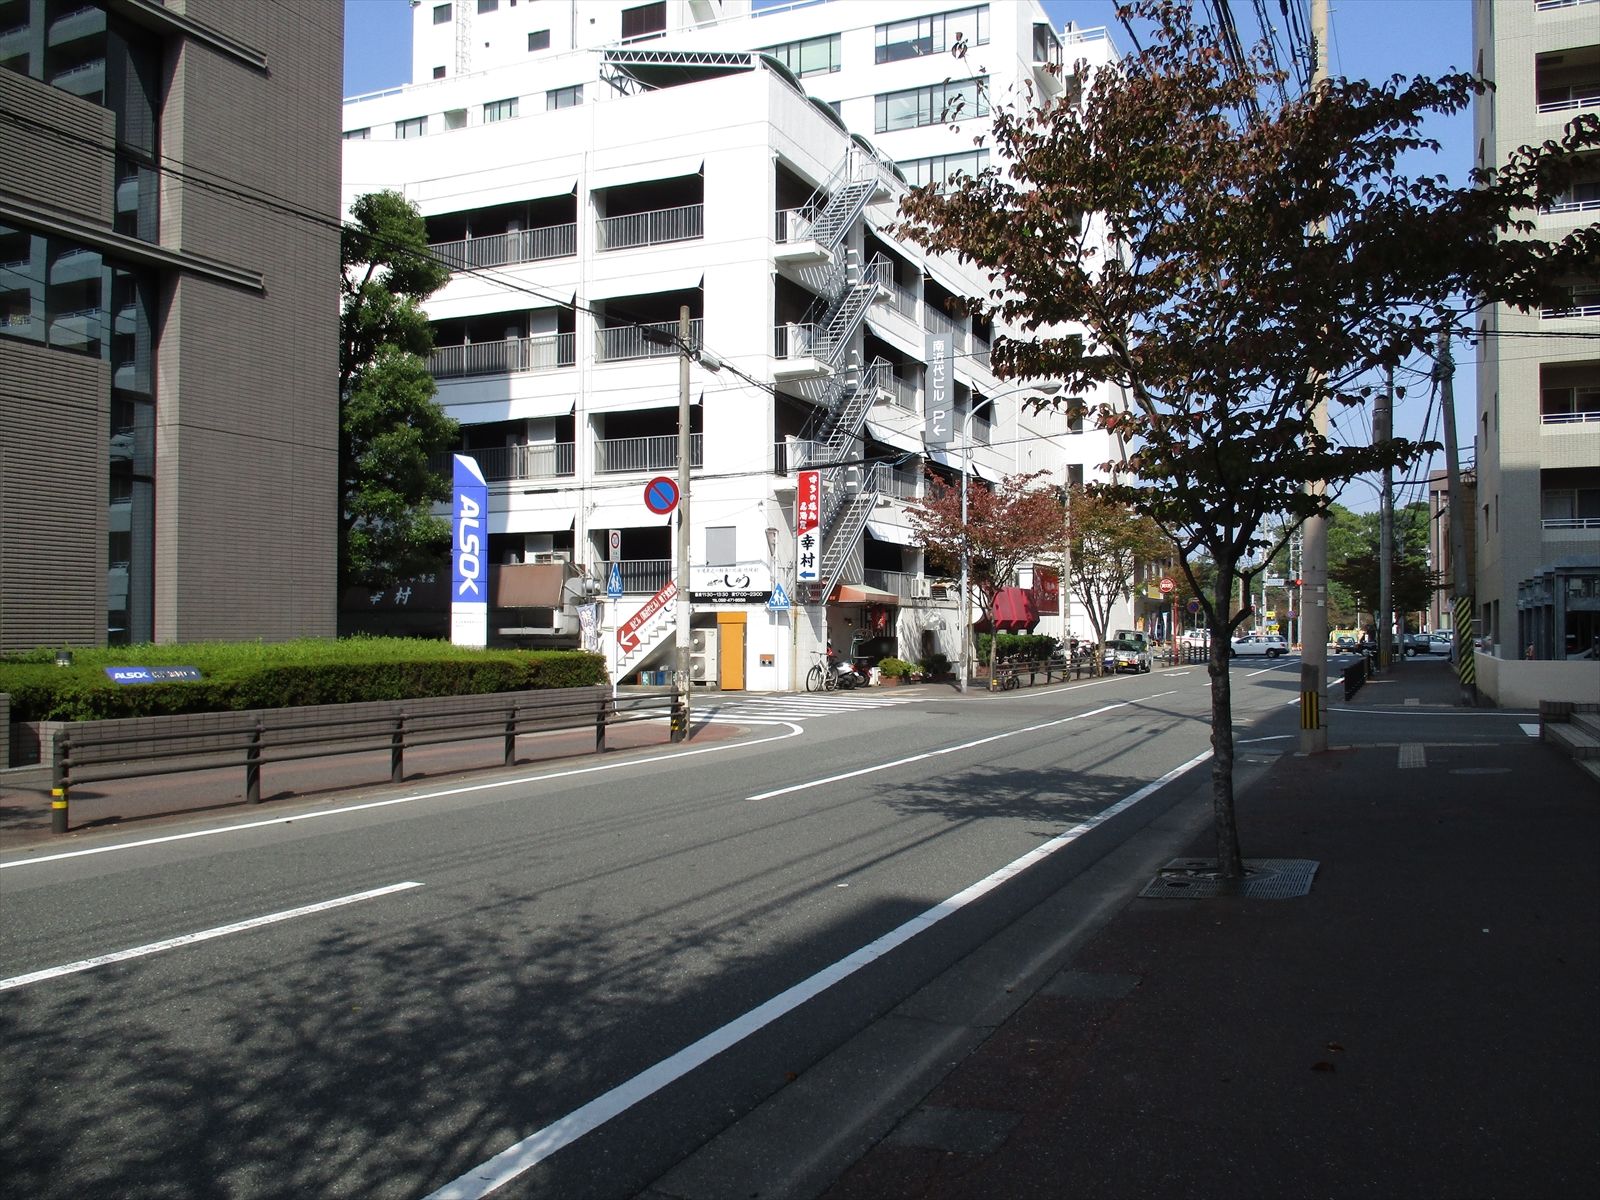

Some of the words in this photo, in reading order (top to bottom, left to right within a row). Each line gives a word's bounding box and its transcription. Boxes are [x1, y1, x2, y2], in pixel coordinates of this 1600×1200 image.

[932, 339, 945, 402] 南近代ビル
[932, 410, 946, 425] P
[459, 494, 480, 596] ALSOK
[800, 533, 815, 568] 幸村
[114, 671, 150, 680] ALSOK
